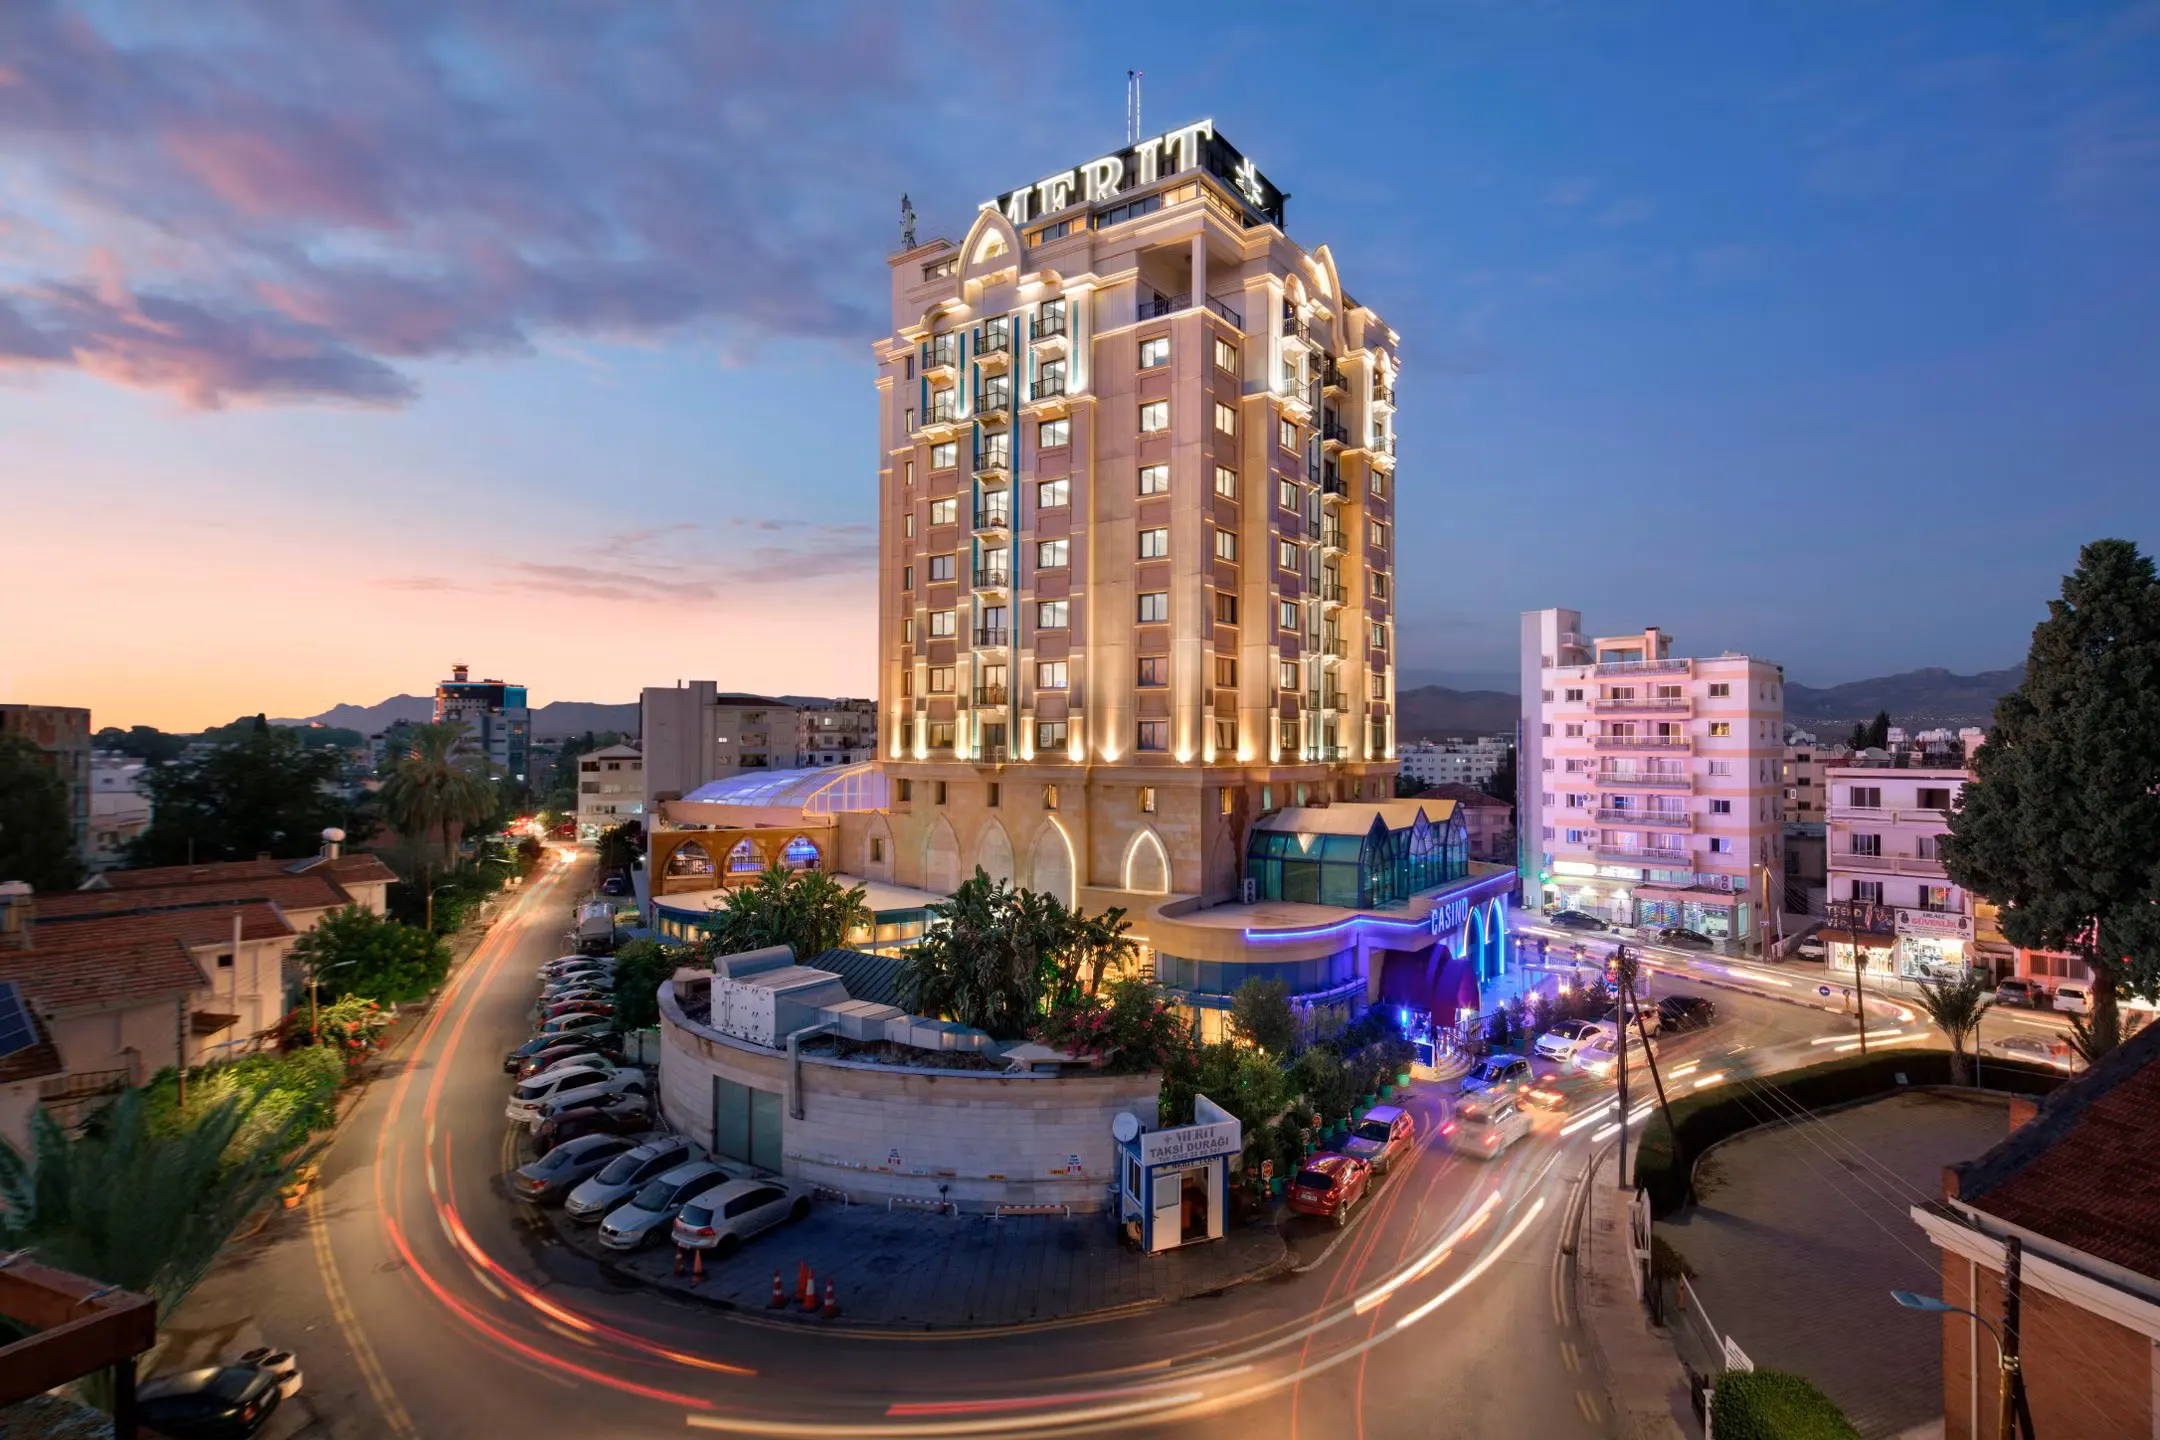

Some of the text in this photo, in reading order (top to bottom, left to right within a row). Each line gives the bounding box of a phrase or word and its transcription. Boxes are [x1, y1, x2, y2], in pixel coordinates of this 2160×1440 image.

[978, 119, 1213, 225] MERIT
[1432, 896, 1468, 935] CASINO
[1150, 1137, 1229, 1158] TAKSİ DURAĞI
